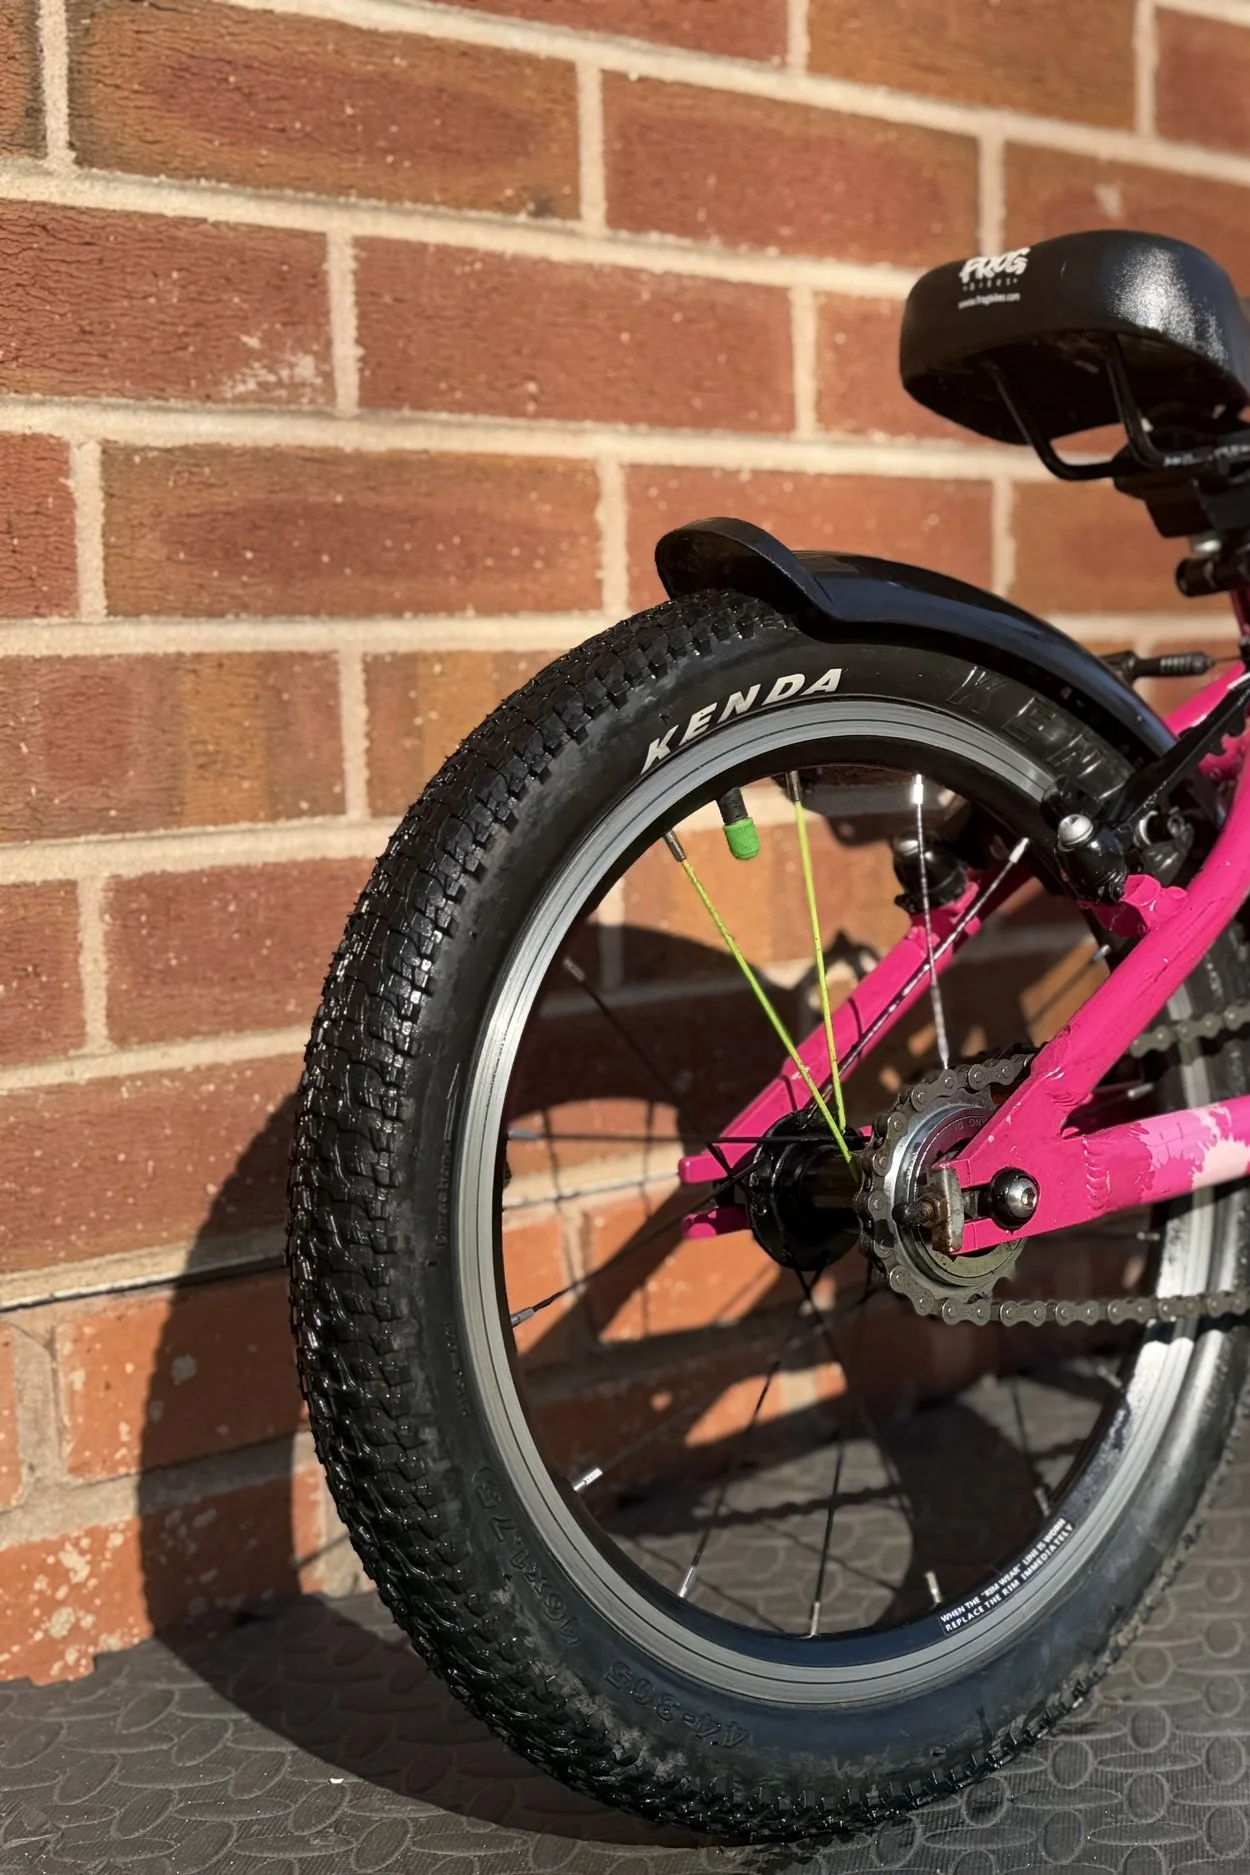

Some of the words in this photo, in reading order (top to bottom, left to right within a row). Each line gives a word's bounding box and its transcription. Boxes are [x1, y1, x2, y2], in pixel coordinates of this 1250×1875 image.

[640, 668, 843, 775] KENDA
[940, 1605, 966, 1622] WHEN
[964, 1596, 981, 1609] THE
[1022, 1548, 1039, 1566] LINE
[1036, 1541, 1047, 1552] IS
[1043, 1518, 1066, 1543] WORN
[945, 1605, 985, 1632] REPLACE
[984, 1593, 1002, 1609] THE
[1001, 1579, 1020, 1596] RIM
[1020, 1523, 1073, 1581] IMMEDIATELY
